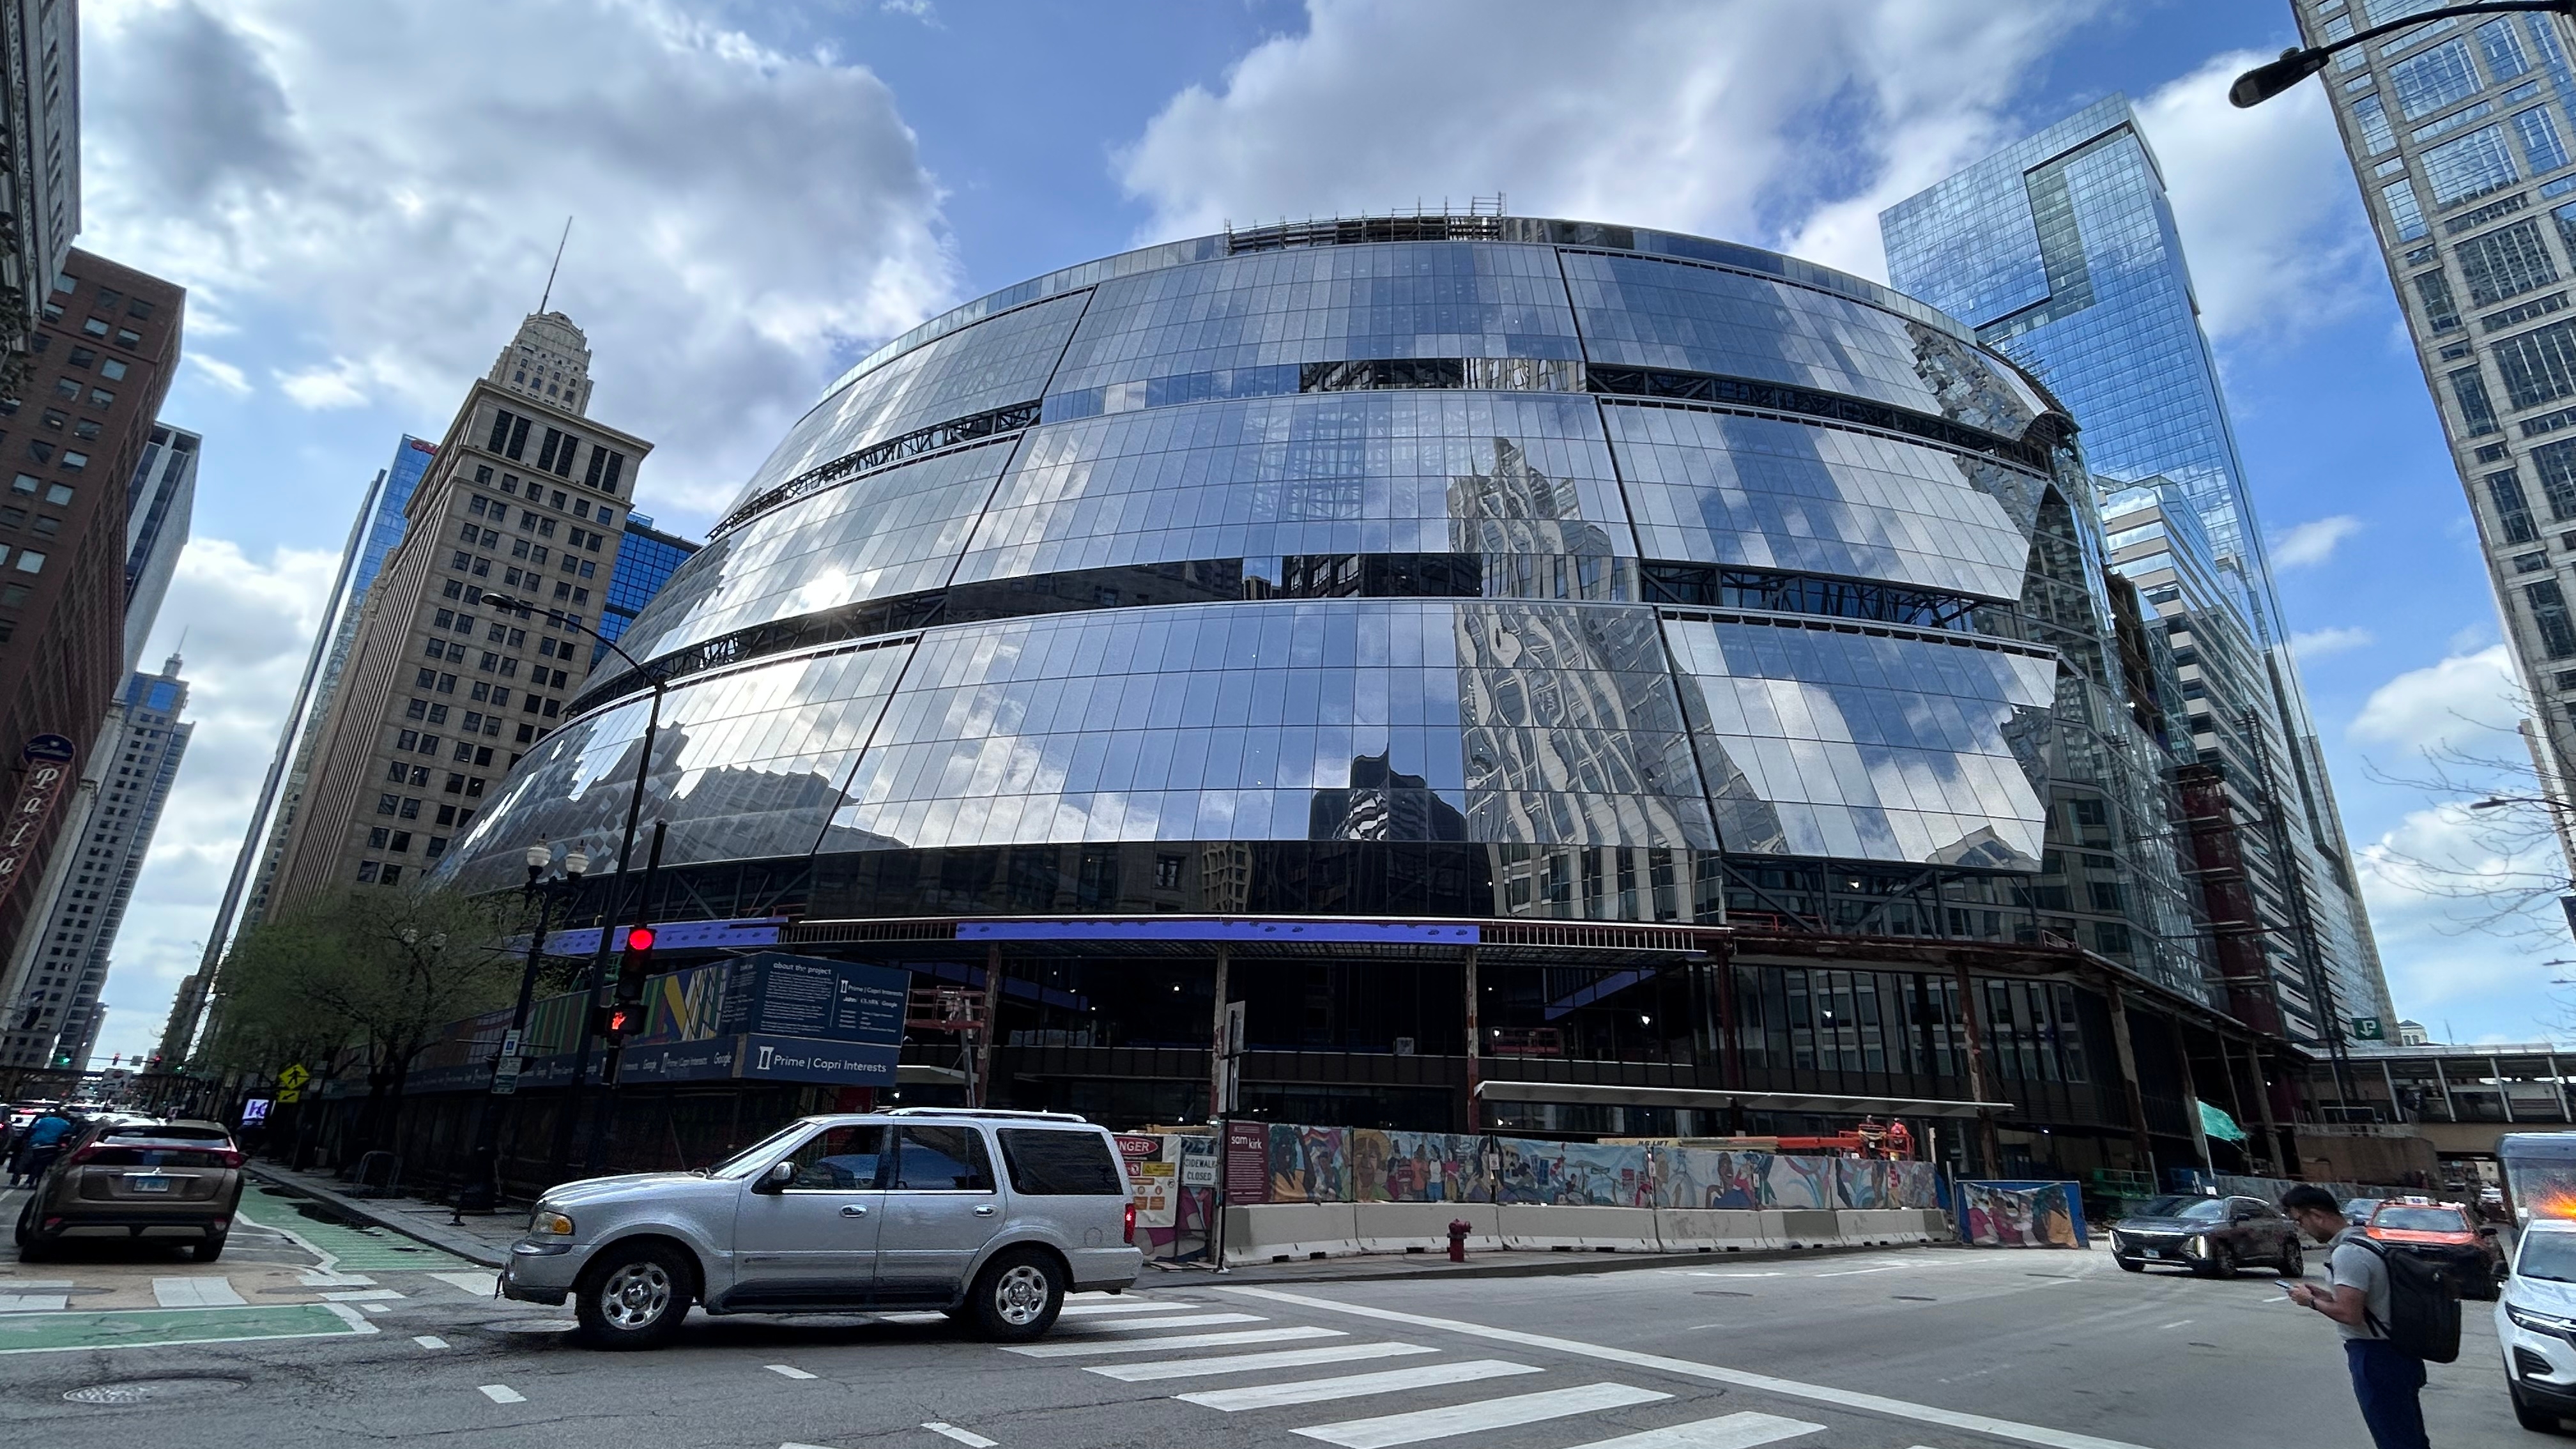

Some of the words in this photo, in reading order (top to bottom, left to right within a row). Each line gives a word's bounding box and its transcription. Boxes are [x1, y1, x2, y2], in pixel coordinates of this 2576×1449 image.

[773, 962, 793, 970] about
[808, 967, 831, 975] project
[774, 1054, 805, 1067] Prime
[813, 1057, 842, 1071] Capri
[843, 1060, 887, 1073] Interests
[1119, 1140, 1149, 1151] NGER
[1231, 1136, 1248, 1145] sam
[1248, 1138, 1262, 1149] kirk
[1185, 1158, 1215, 1168] SIDEWALK
[1187, 1171, 1212, 1181] CLOSED
